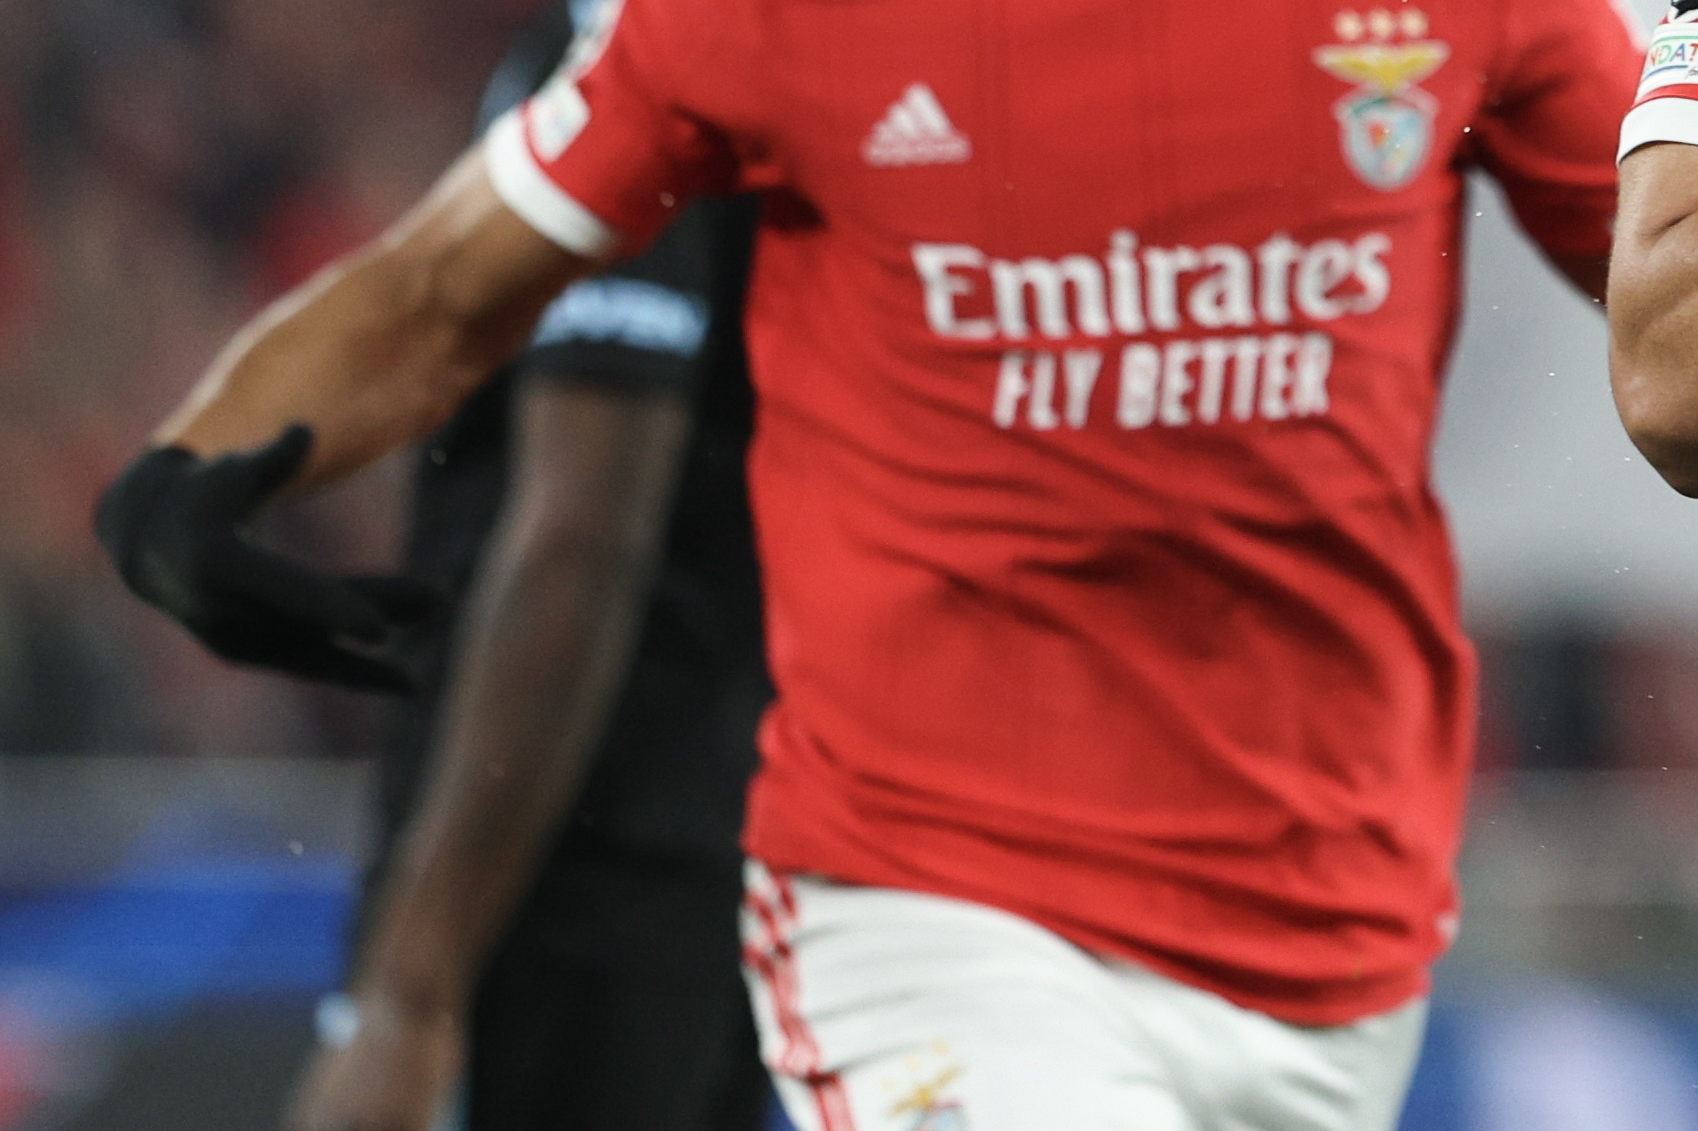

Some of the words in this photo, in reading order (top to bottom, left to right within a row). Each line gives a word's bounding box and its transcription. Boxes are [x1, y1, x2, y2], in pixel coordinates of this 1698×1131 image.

[910, 227, 1393, 341] Emirates
[992, 348, 1103, 431] FLY
[1115, 330, 1333, 431] BETTER
